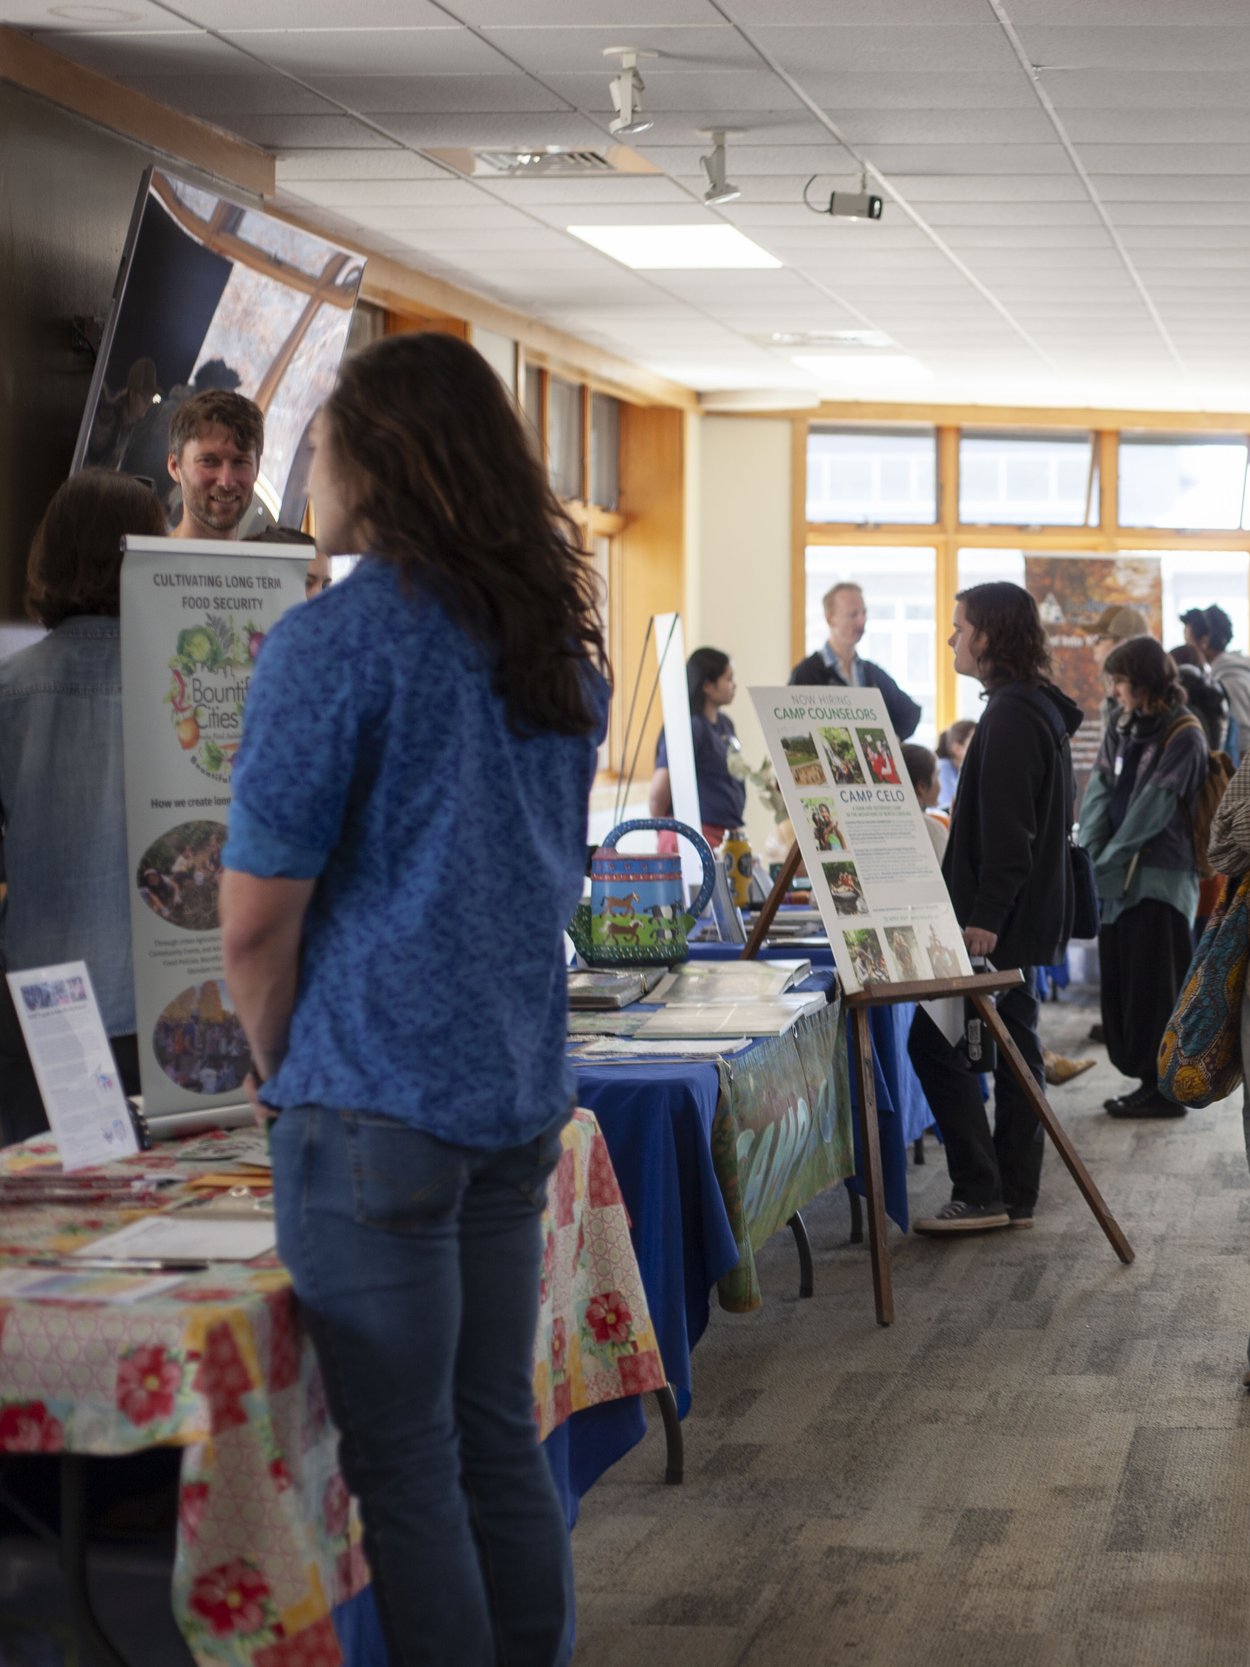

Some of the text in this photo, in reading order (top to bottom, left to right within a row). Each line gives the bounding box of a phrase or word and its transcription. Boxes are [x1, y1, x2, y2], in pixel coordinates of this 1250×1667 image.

[152, 573, 282, 590] CULTIVATING LONG TERM
[182, 596, 263, 610] FOOD SECURITY
[192, 676, 252, 704] Bountif
[791, 695, 851, 706] NOW HIRING
[193, 703, 239, 730] Cities
[773, 707, 877, 721] CAMP COUNSELORS
[150, 799, 172, 809] How
[188, 798, 212, 807] create
[214, 796, 231, 806] lon
[840, 789, 905, 803] CAMP CELO
